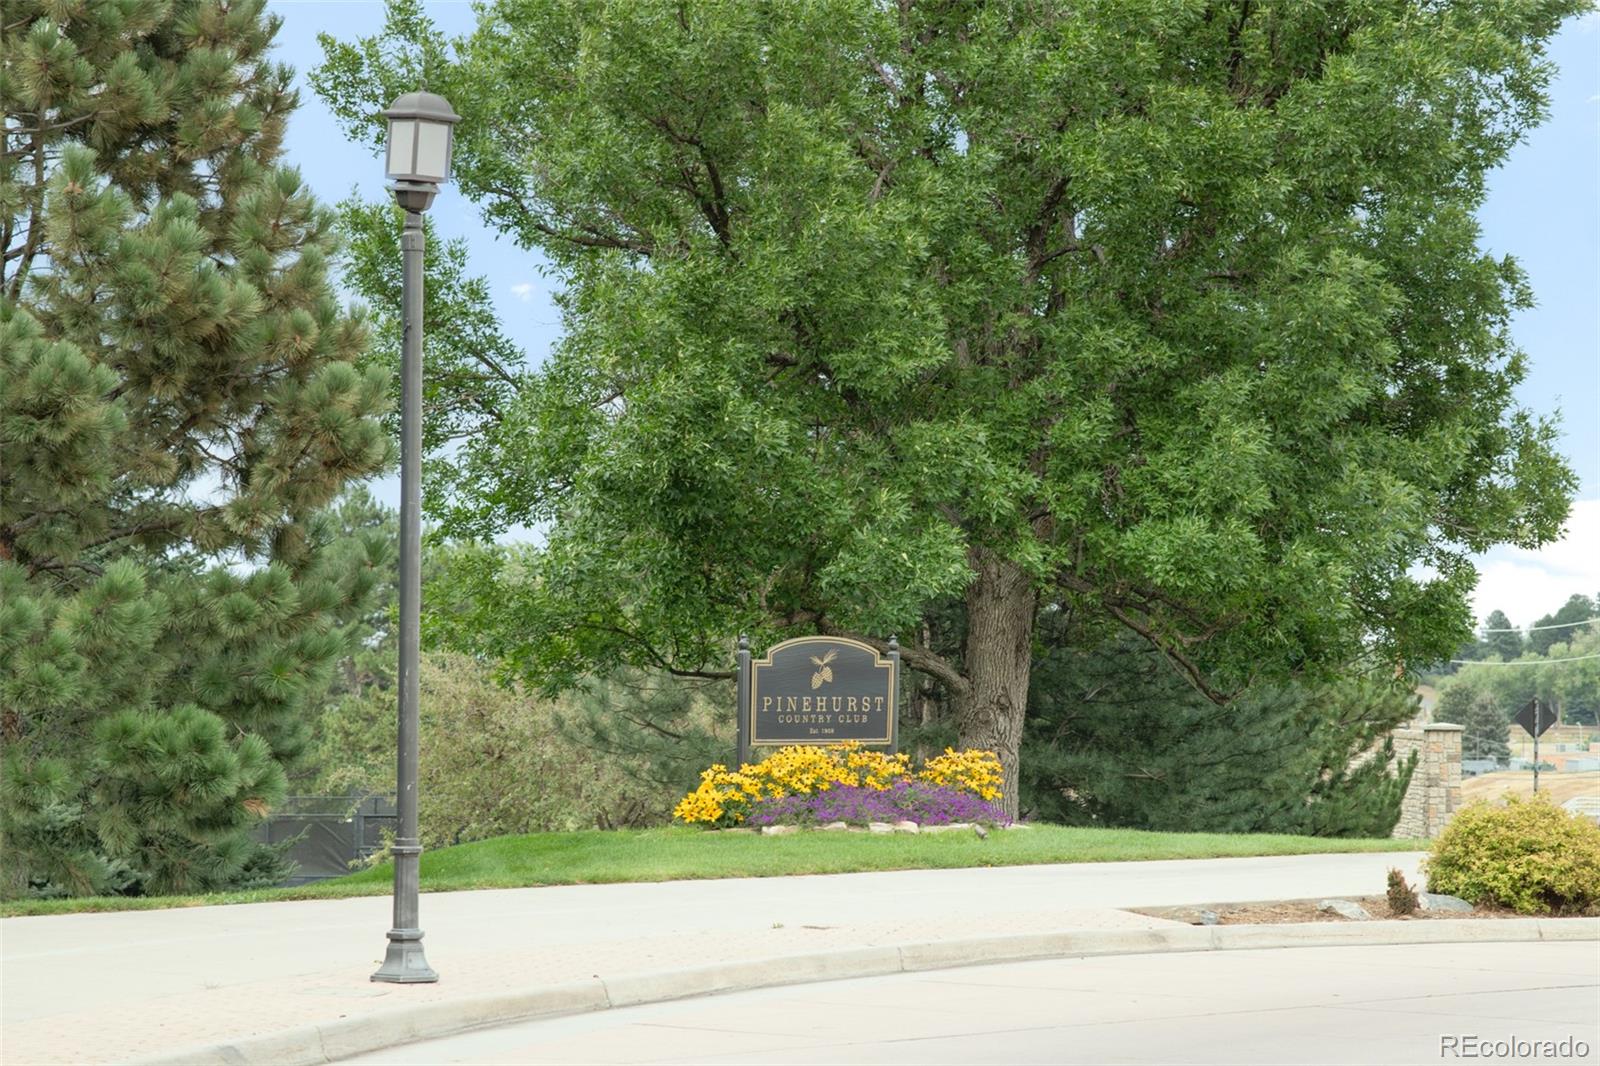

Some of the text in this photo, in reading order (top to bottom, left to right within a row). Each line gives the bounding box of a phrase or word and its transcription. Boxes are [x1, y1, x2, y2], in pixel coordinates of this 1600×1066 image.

[762, 696, 884, 712] PINEHURST
[778, 714, 868, 723] COUNTRY CLUB
